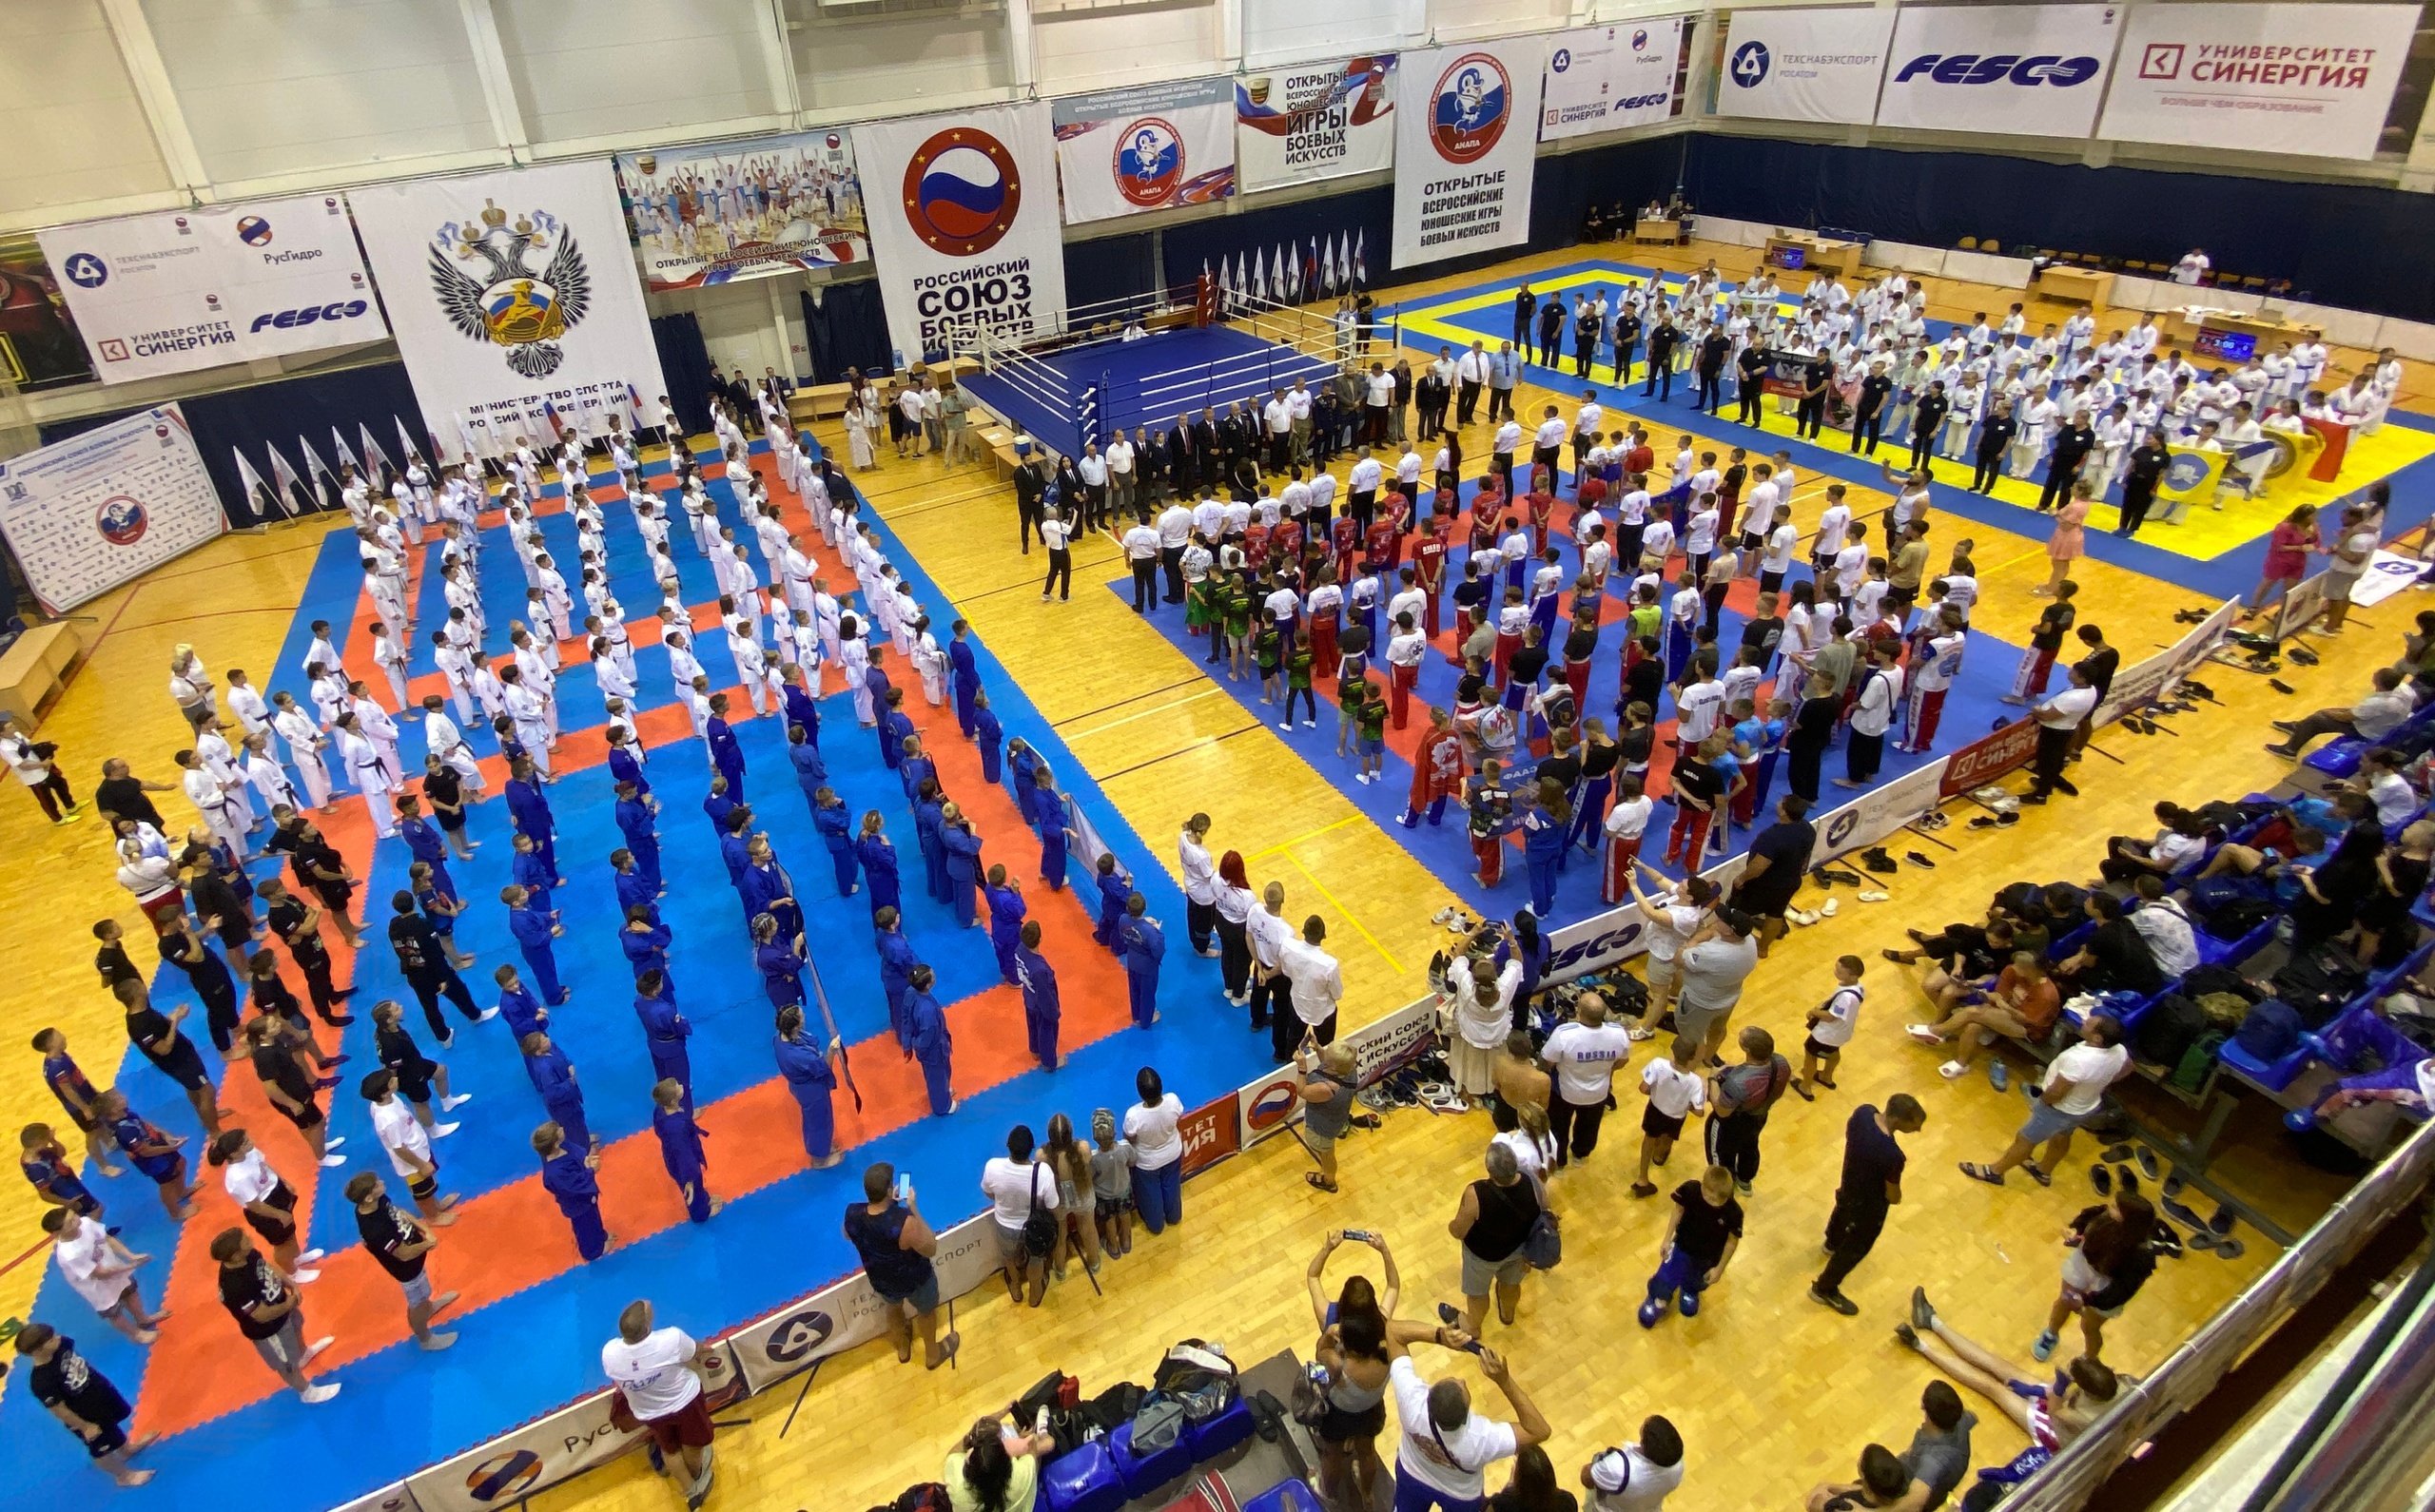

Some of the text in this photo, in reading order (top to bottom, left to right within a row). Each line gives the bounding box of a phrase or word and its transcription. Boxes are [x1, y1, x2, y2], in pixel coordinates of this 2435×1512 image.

[1782, 54, 1878, 65] ТЕХСНАБЭКСПОРТ
[2197, 44, 2377, 64] УНИВЕРСИТЕТ
[1286, 70, 1349, 89] ОТКРЫТЫЕ
[1893, 54, 2100, 87] FESCO
[2191, 61, 2370, 89] СИНЕРГИЯ
[1286, 85, 1349, 100] ВСЕРОССИЙСКИЕ
[1286, 95, 1347, 111] ЮНОШЕСКИЕ
[1613, 92, 1667, 111] FESCO
[1286, 107, 1347, 135] ИГРЫ
[1560, 108, 1606, 124] СИНЕРГИЯ
[1286, 129, 1346, 152] БОЕВЫХ
[1454, 139, 1480, 150] АНАПА
[1286, 145, 1347, 165] ИСКУССТВ
[1424, 170, 1506, 195] ОТКРЫТЫЕ
[1422, 187, 1504, 215] ВСЕРОССИЙСКИЕ
[1420, 204, 1502, 231] ЮНОШЕСКИЕ ИГРЫ
[1420, 221, 1500, 247] БОЕВЫХ ИСКУССТВ
[263, 248, 322, 265] РусГидро
[655, 232, 857, 269] ОТКРЫТЫЕ ВСЕРОССИЙСКИЕ ЮНОШЕСКИЕ
[700, 262, 729, 274] ИГРЫ
[730, 256, 770, 269] БОЕВЫХ
[774, 248, 821, 262] ИСКУССТВ
[914, 257, 1030, 291] РОССИЙСКИЙ
[917, 274, 1032, 318] СОЮЗ
[249, 300, 367, 333] FESCO
[920, 301, 1032, 339] БОЕВЫХ
[129, 320, 230, 344] УНИВЕРСИТЕТ
[135, 330, 236, 358] СИНЕРГИЯ
[922, 320, 1035, 353] ИСКУСТВ
[1358, 1013, 1430, 1054] СКИЙ СОЮЗ
[1367, 1024, 1429, 1063] ИСКУССТВ
[1577, 1050, 1616, 1061] RUSSIA
[1183, 1115, 1216, 1136] ТЕТ
[1182, 1128, 1216, 1157] ИЯ
